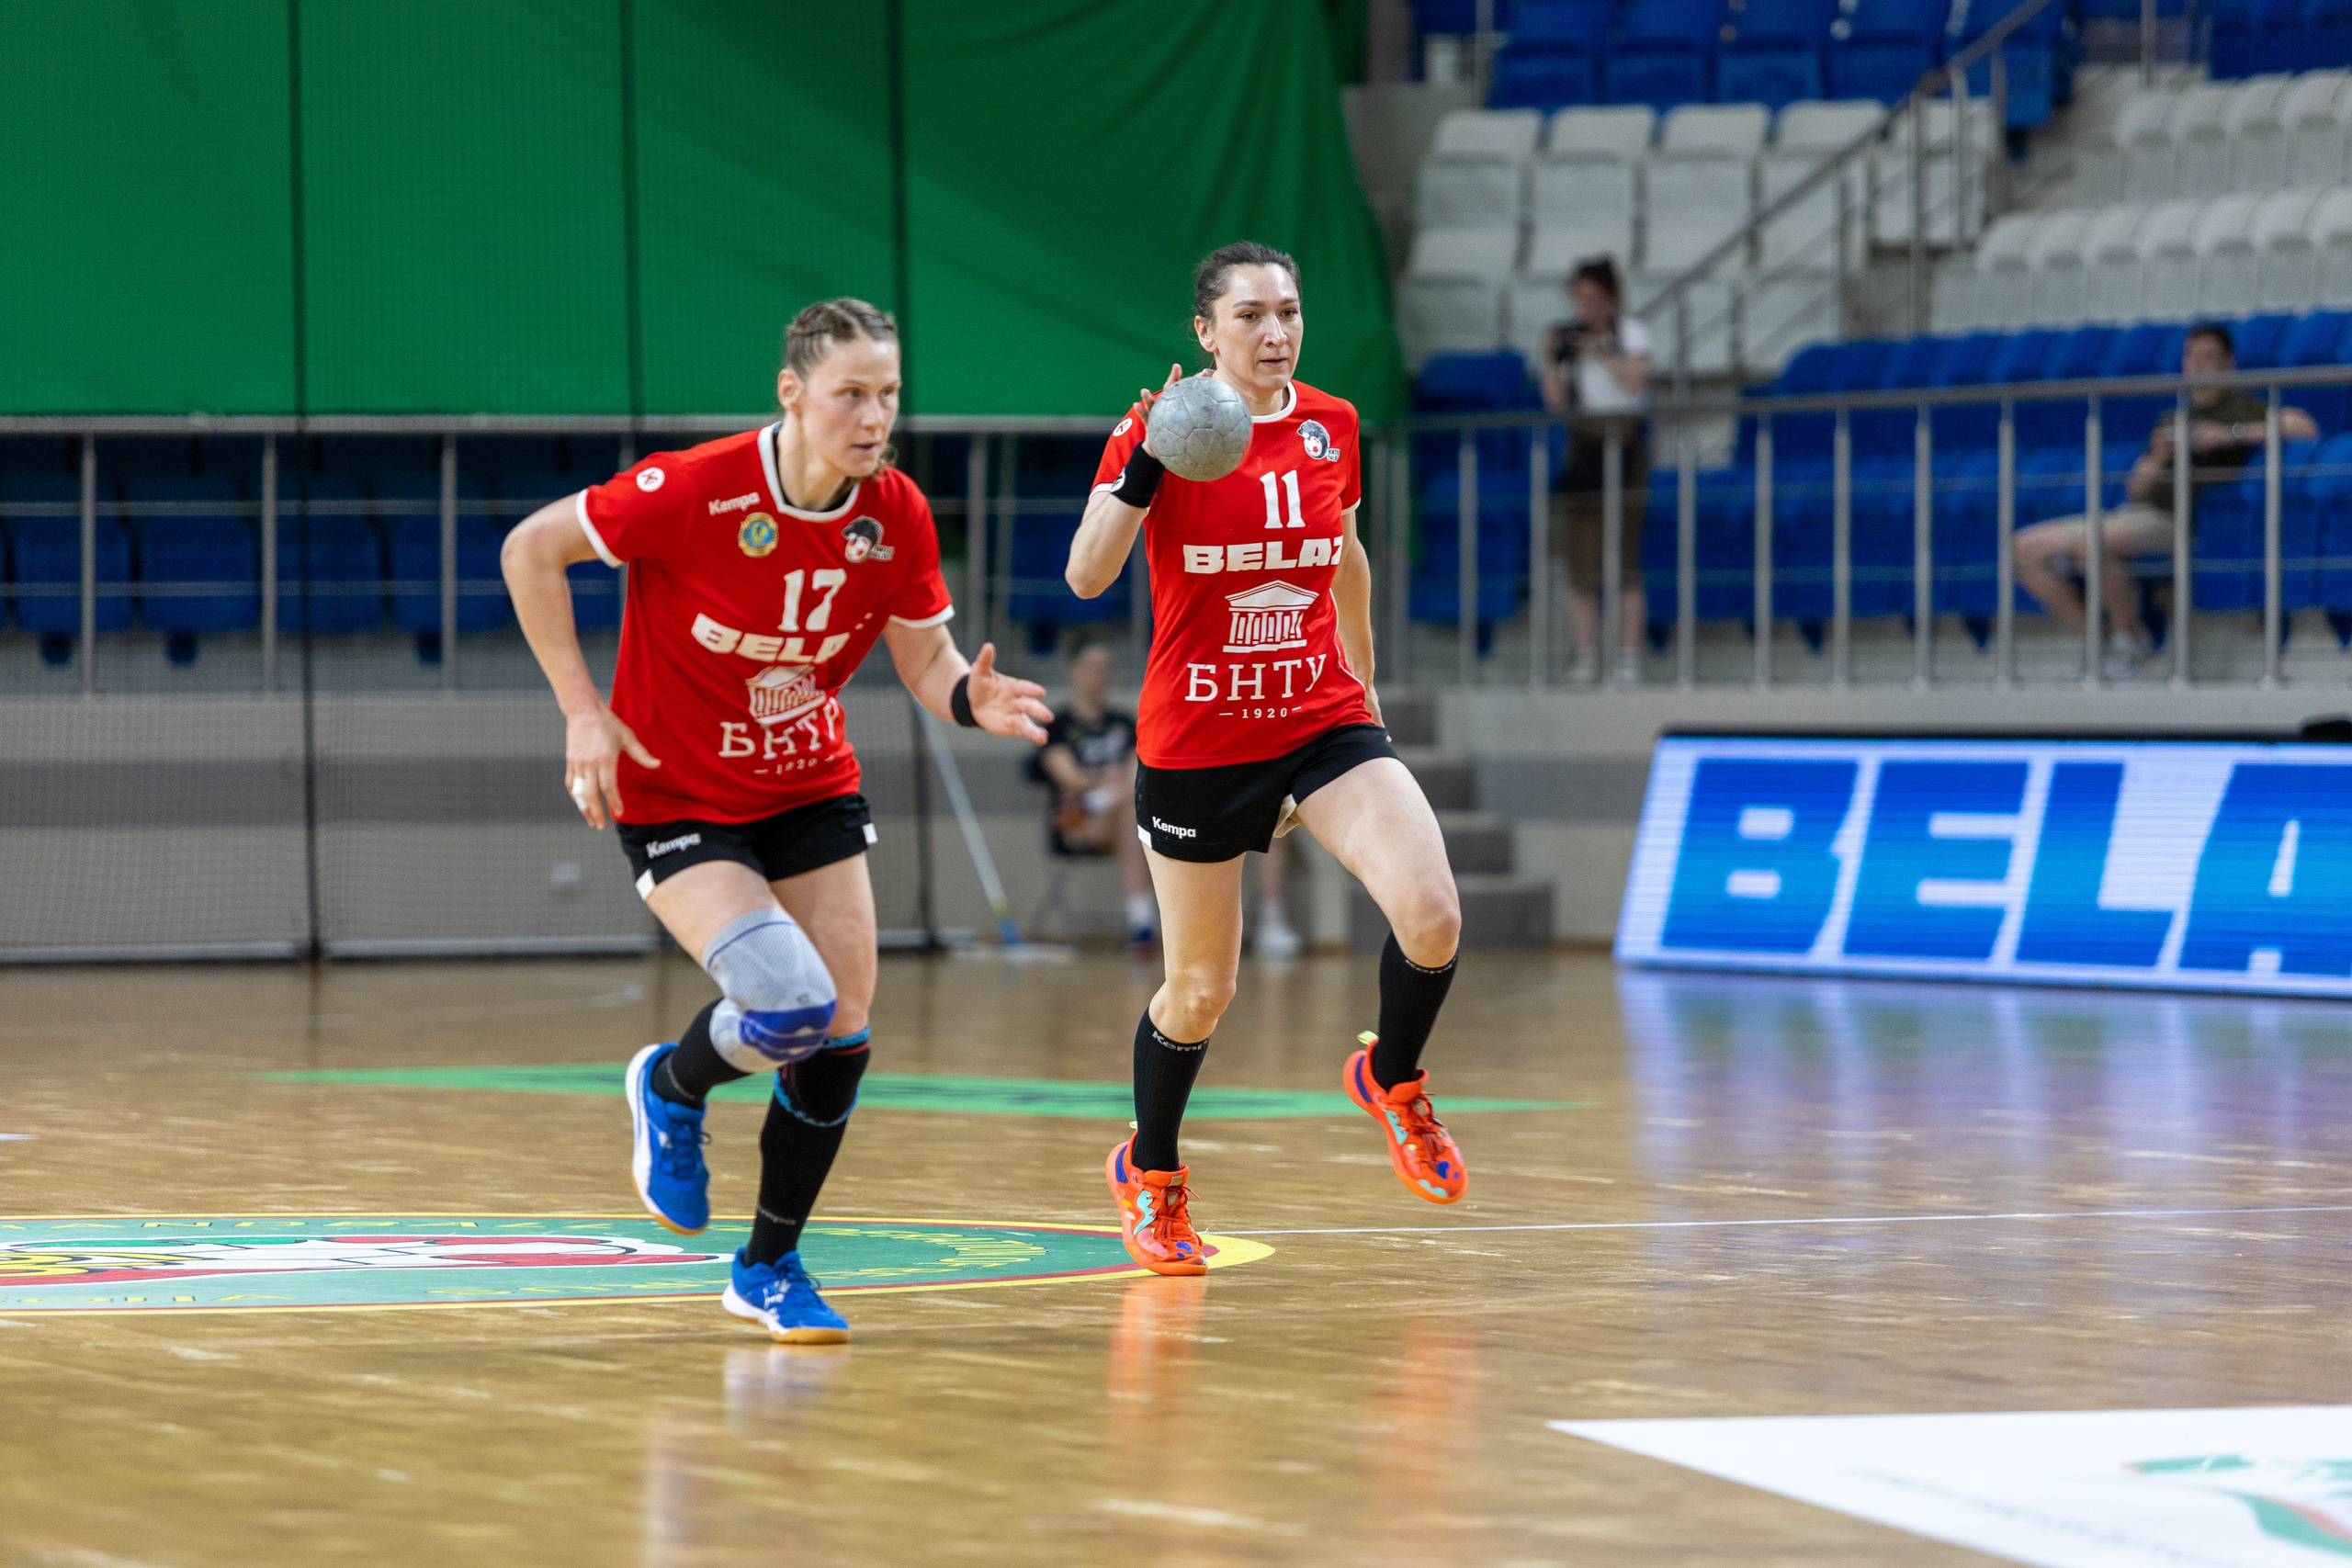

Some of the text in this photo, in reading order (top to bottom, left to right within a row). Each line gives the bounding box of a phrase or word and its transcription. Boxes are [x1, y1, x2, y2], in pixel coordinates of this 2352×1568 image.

[707, 491, 761, 515] Kempa
[1260, 469, 1306, 529] 11
[777, 568, 847, 633] 17
[1184, 653, 1327, 702] БНТУ
[646, 832, 702, 859] Kempa
[1151, 817, 1197, 839] Kempa
